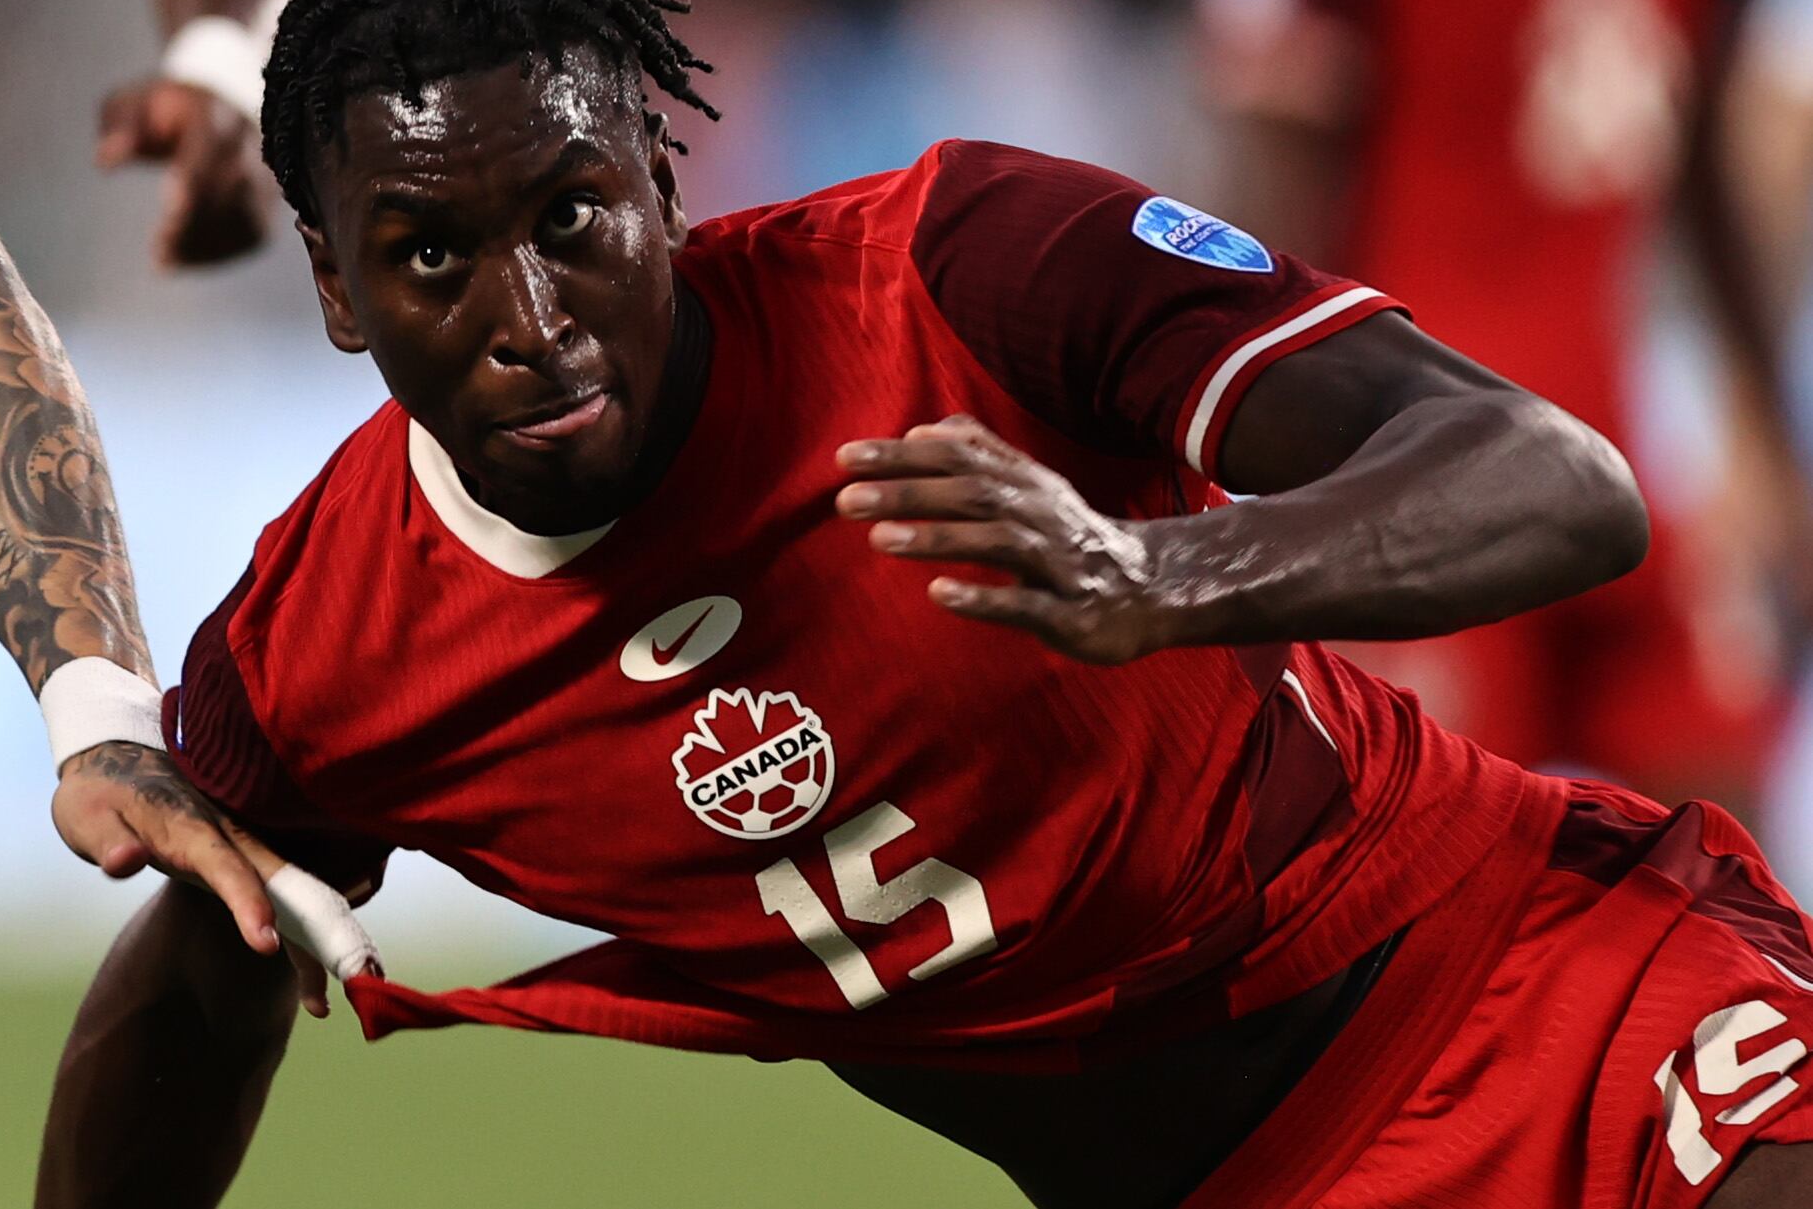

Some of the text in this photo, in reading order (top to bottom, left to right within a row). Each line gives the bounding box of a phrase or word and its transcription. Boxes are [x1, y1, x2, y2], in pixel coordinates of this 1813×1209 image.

[690, 727, 822, 806] CANADA
[754, 800, 998, 1011] 15
[1653, 999, 1807, 1186] 15
